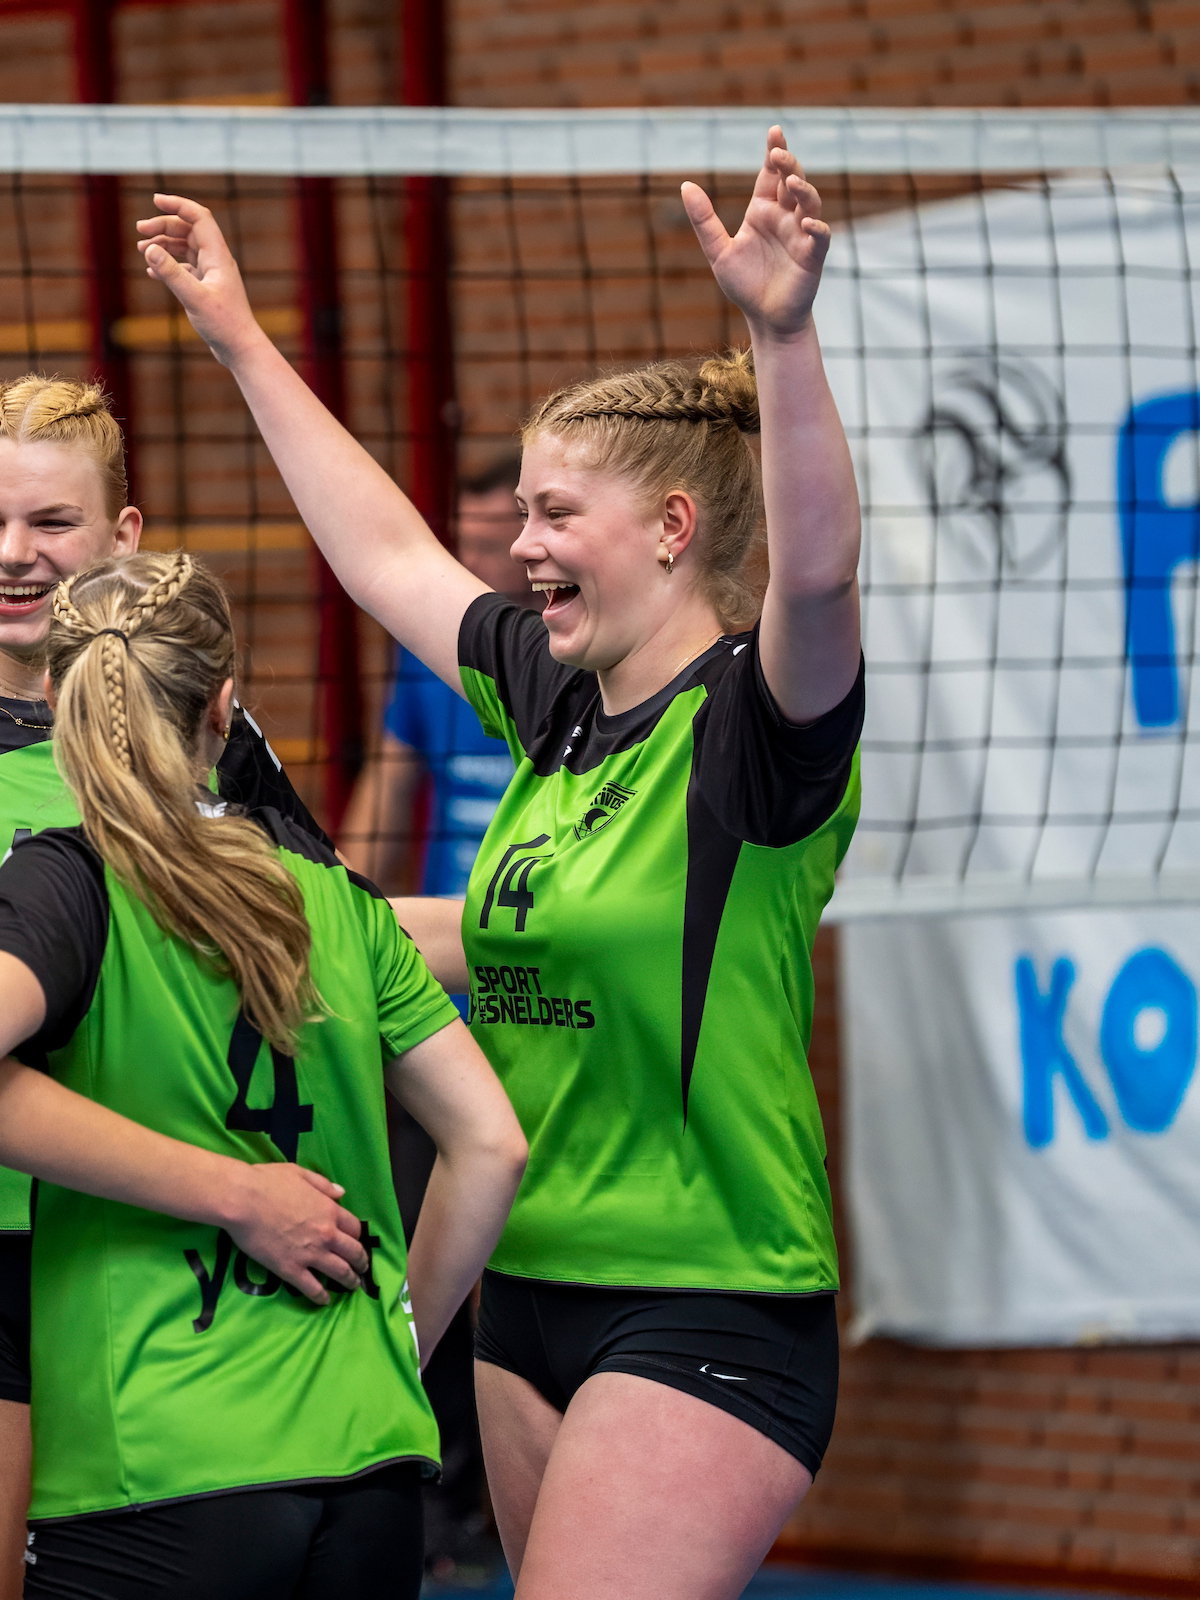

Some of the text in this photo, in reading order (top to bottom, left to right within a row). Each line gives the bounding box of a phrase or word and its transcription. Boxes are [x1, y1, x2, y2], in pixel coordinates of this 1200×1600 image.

[479, 833, 553, 933] 14
[474, 965, 543, 995] SPORT
[485, 994, 596, 1029] SNELDERS
[226, 1003, 314, 1165] 4
[183, 1220, 381, 1334] yot
